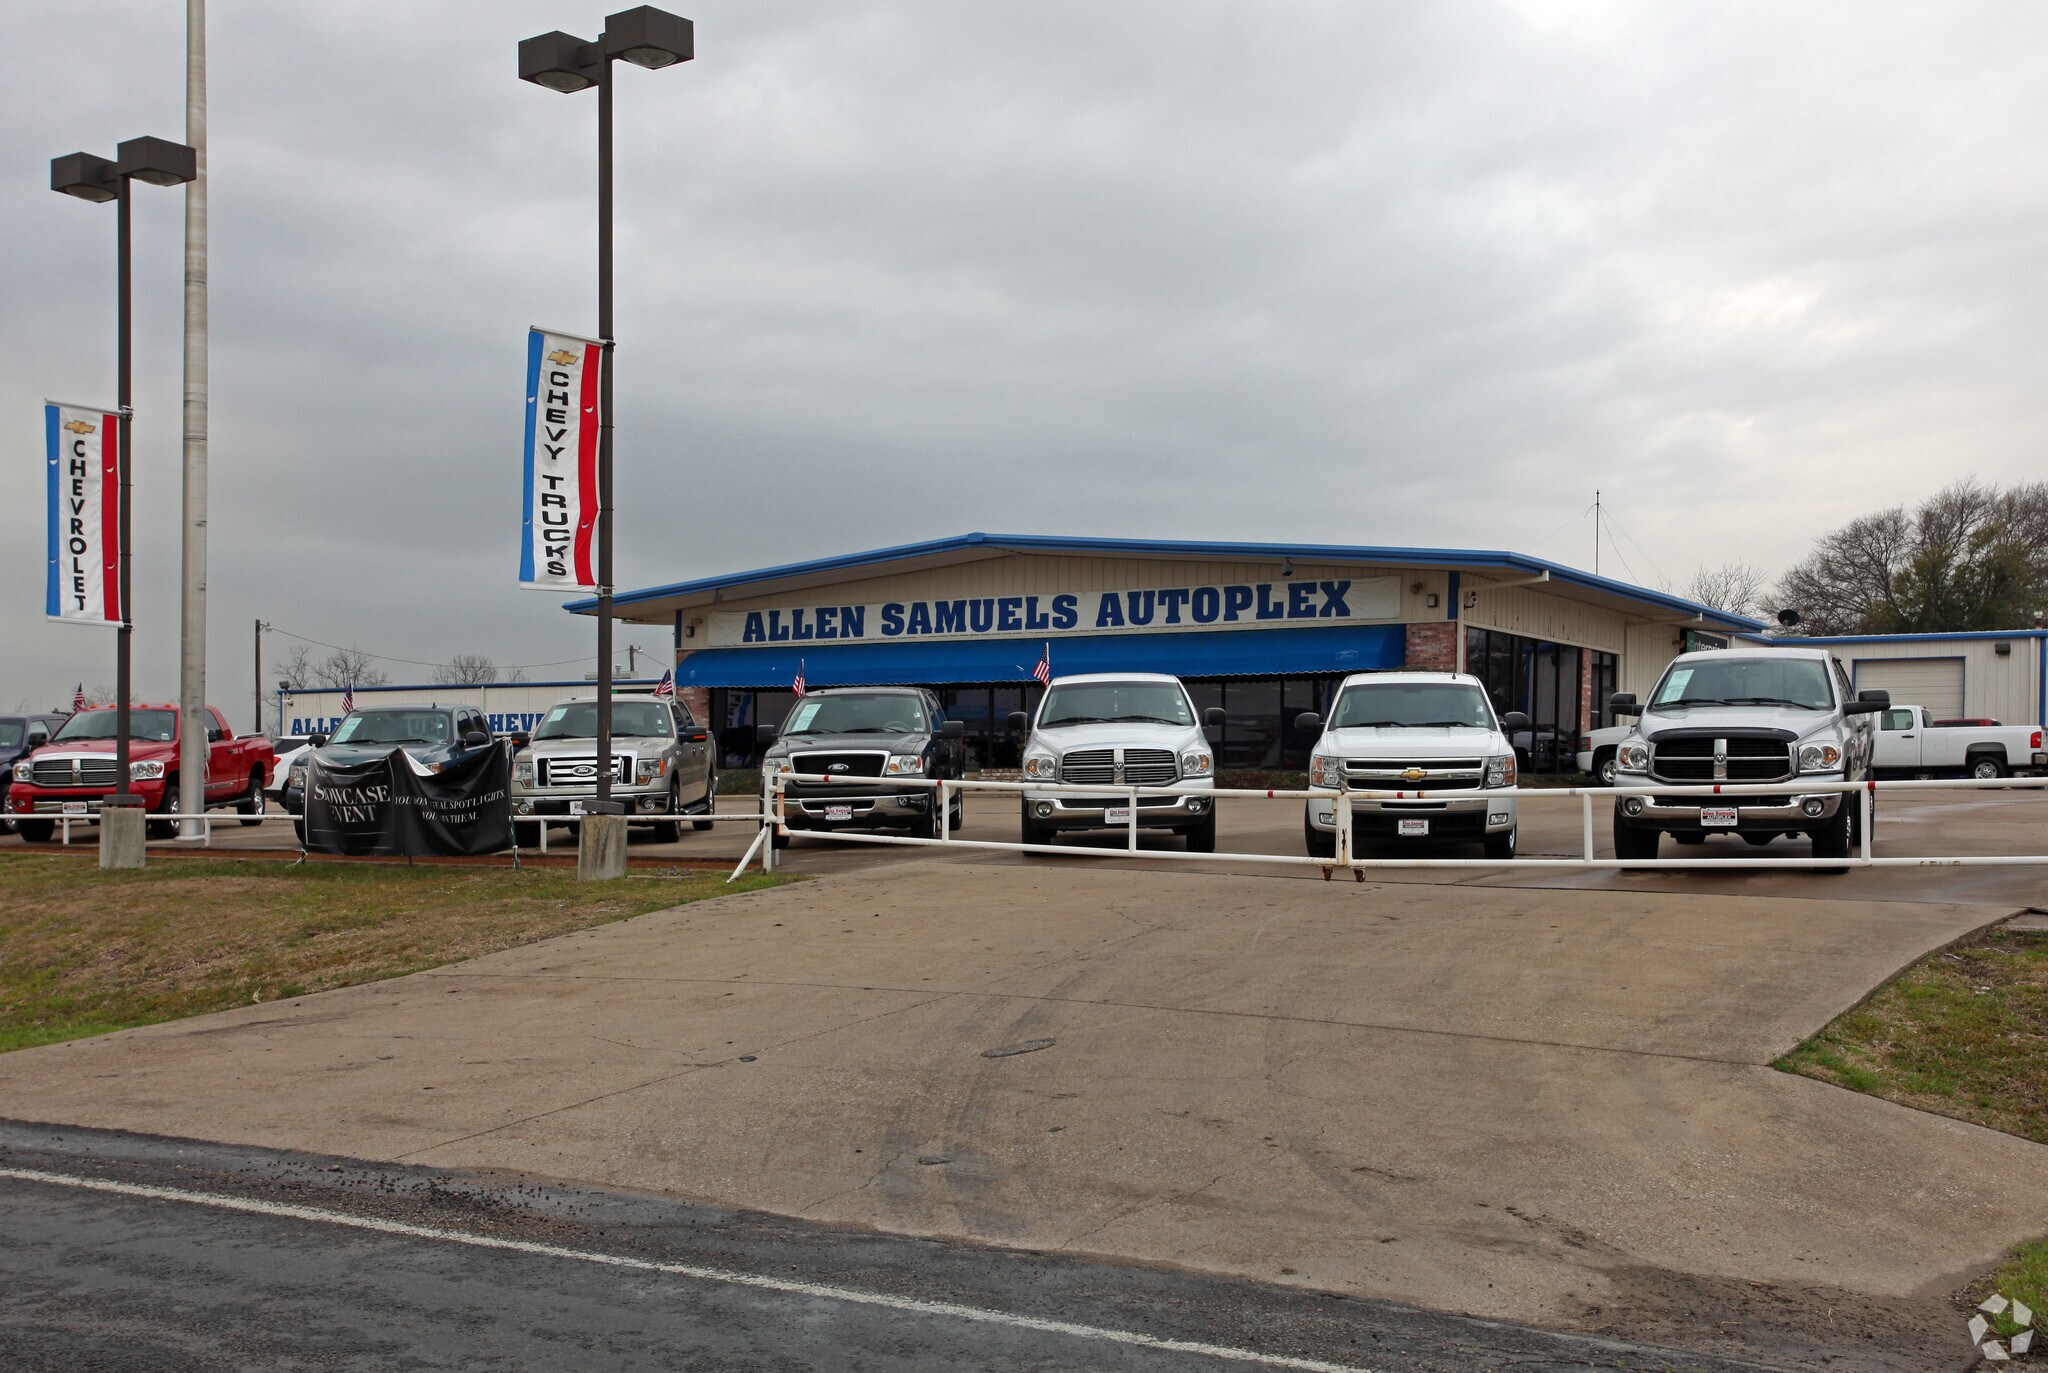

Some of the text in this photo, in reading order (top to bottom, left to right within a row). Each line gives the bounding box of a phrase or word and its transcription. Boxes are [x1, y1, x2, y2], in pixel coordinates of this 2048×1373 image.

[541, 370, 571, 576] CHEVY TRUCKS
[69, 440, 87, 611] CHEVROLET
[742, 580, 1351, 643] ALLEN SAMUELS AUTOPLEX
[291, 717, 342, 736] ALLE
[314, 783, 391, 806] SOWCASE
